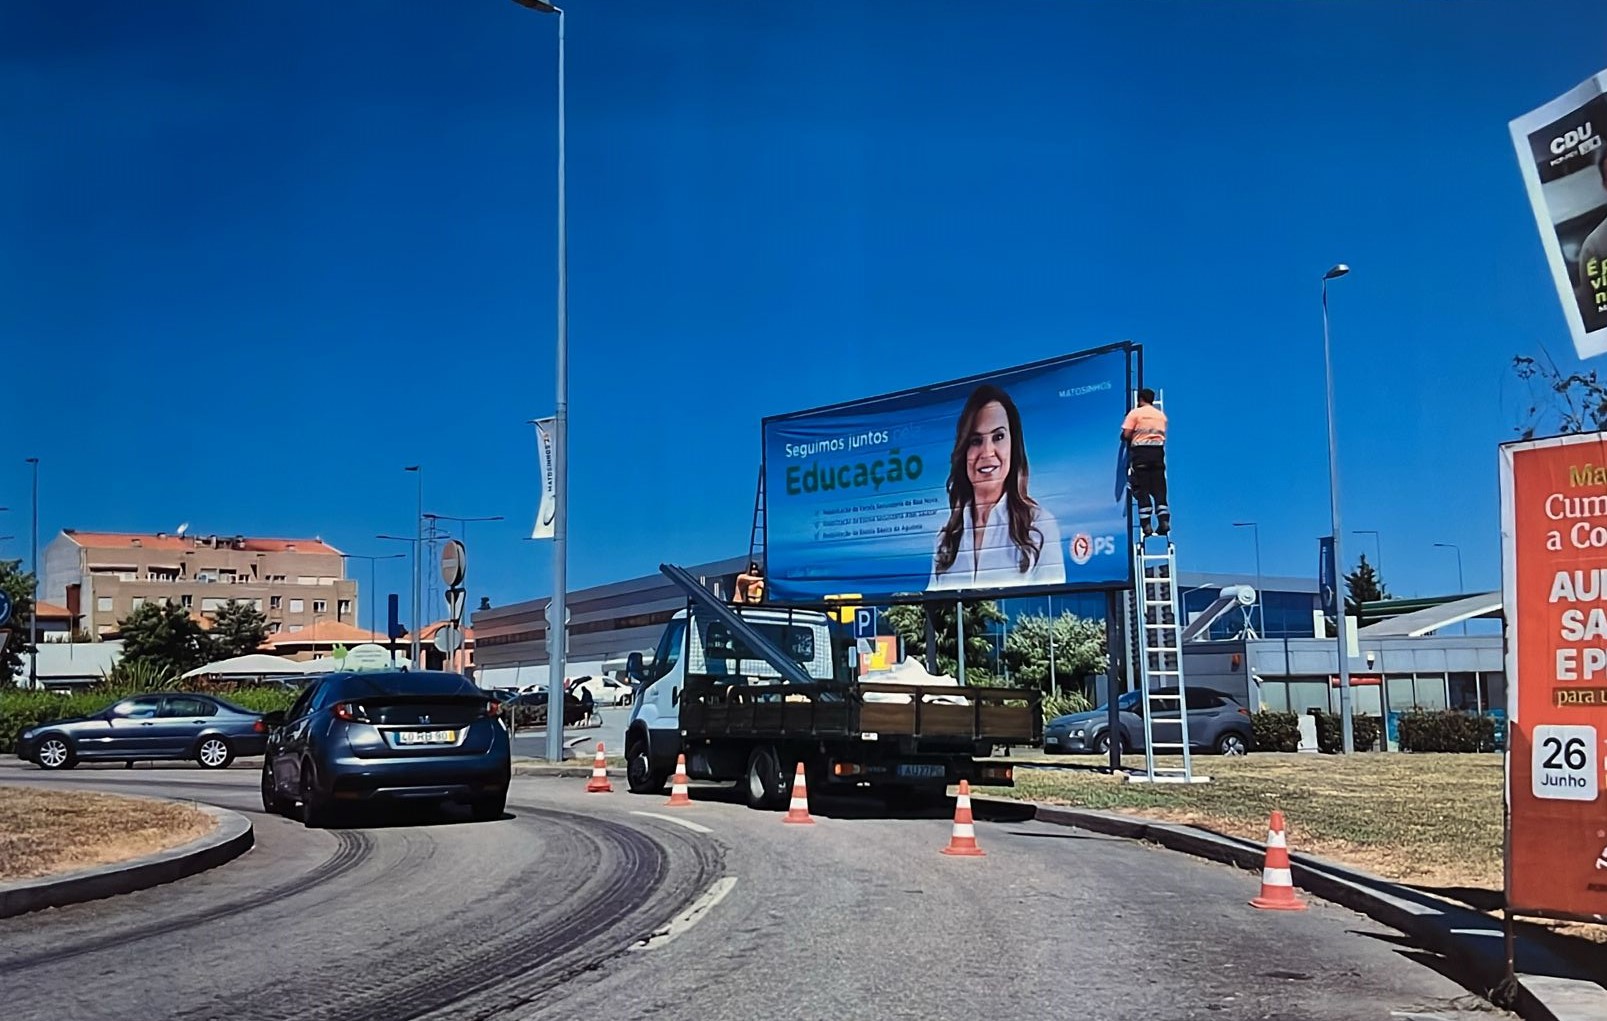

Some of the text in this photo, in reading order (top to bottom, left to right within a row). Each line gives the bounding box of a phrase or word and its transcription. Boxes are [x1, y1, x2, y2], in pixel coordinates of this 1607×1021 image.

[1550, 121, 1592, 154] CDU
[786, 437, 844, 458] Seguimos
[848, 430, 888, 451] juntos
[786, 448, 923, 495] Educação
[1545, 494, 1607, 520] Cum
[1094, 536, 1115, 556] PS
[1546, 522, 1607, 550] a Co
[858, 610, 871, 636] P
[1556, 690, 1595, 709] para
[1542, 737, 1587, 770] 26
[1541, 773, 1587, 788] Junho
